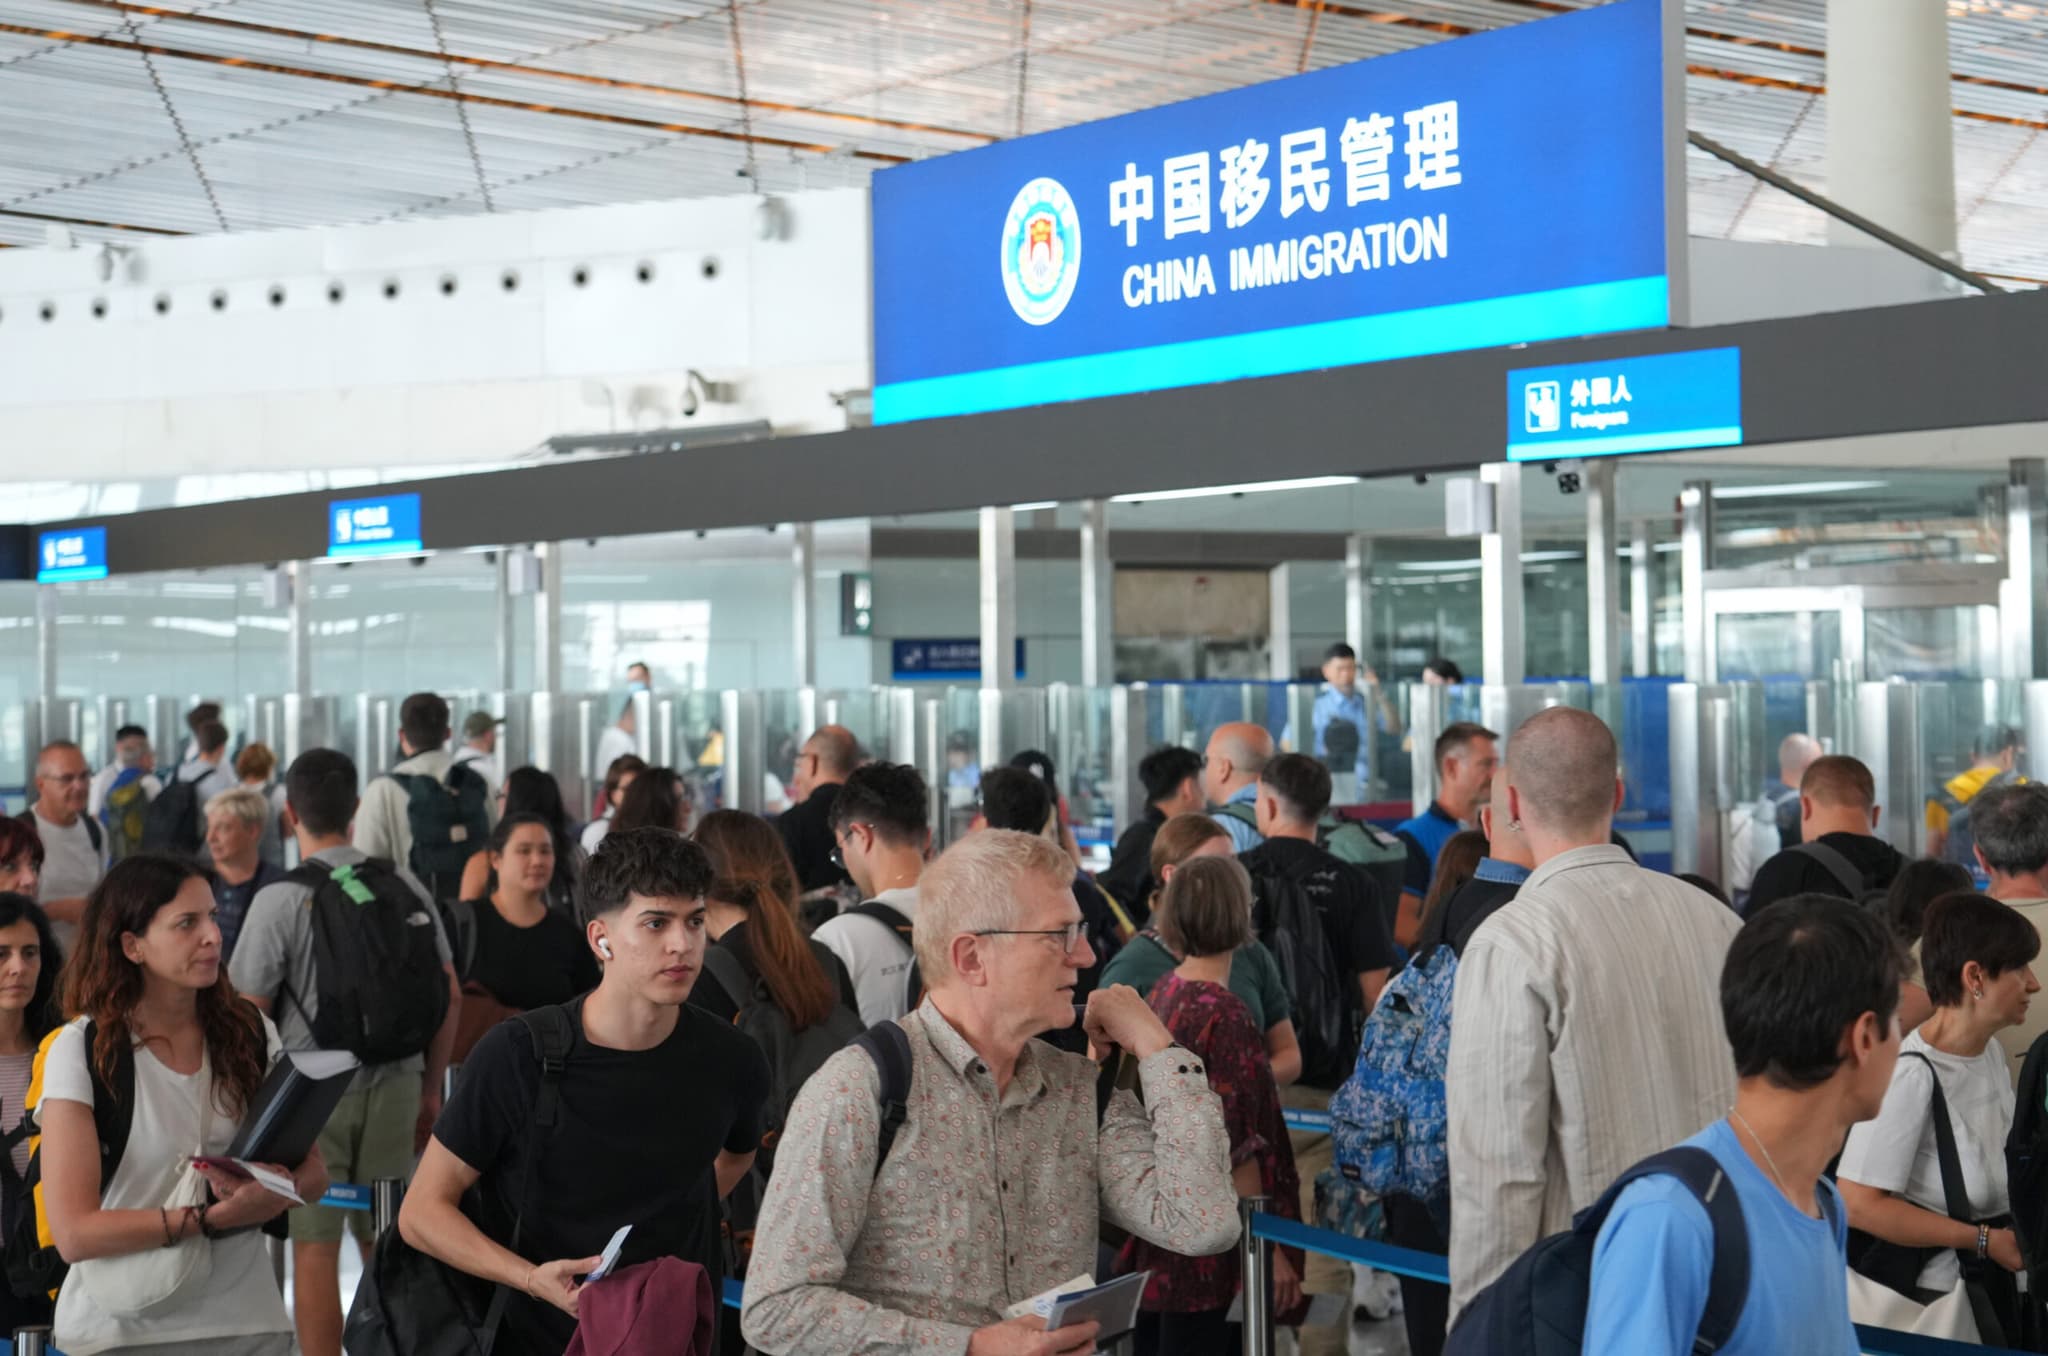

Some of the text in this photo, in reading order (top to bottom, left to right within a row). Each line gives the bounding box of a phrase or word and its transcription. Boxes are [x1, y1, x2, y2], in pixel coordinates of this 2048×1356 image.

[1109, 100, 1462, 247] 中国移民管理
[1122, 253, 1216, 307] CHINA
[1229, 212, 1448, 291] IMMIGRATION
